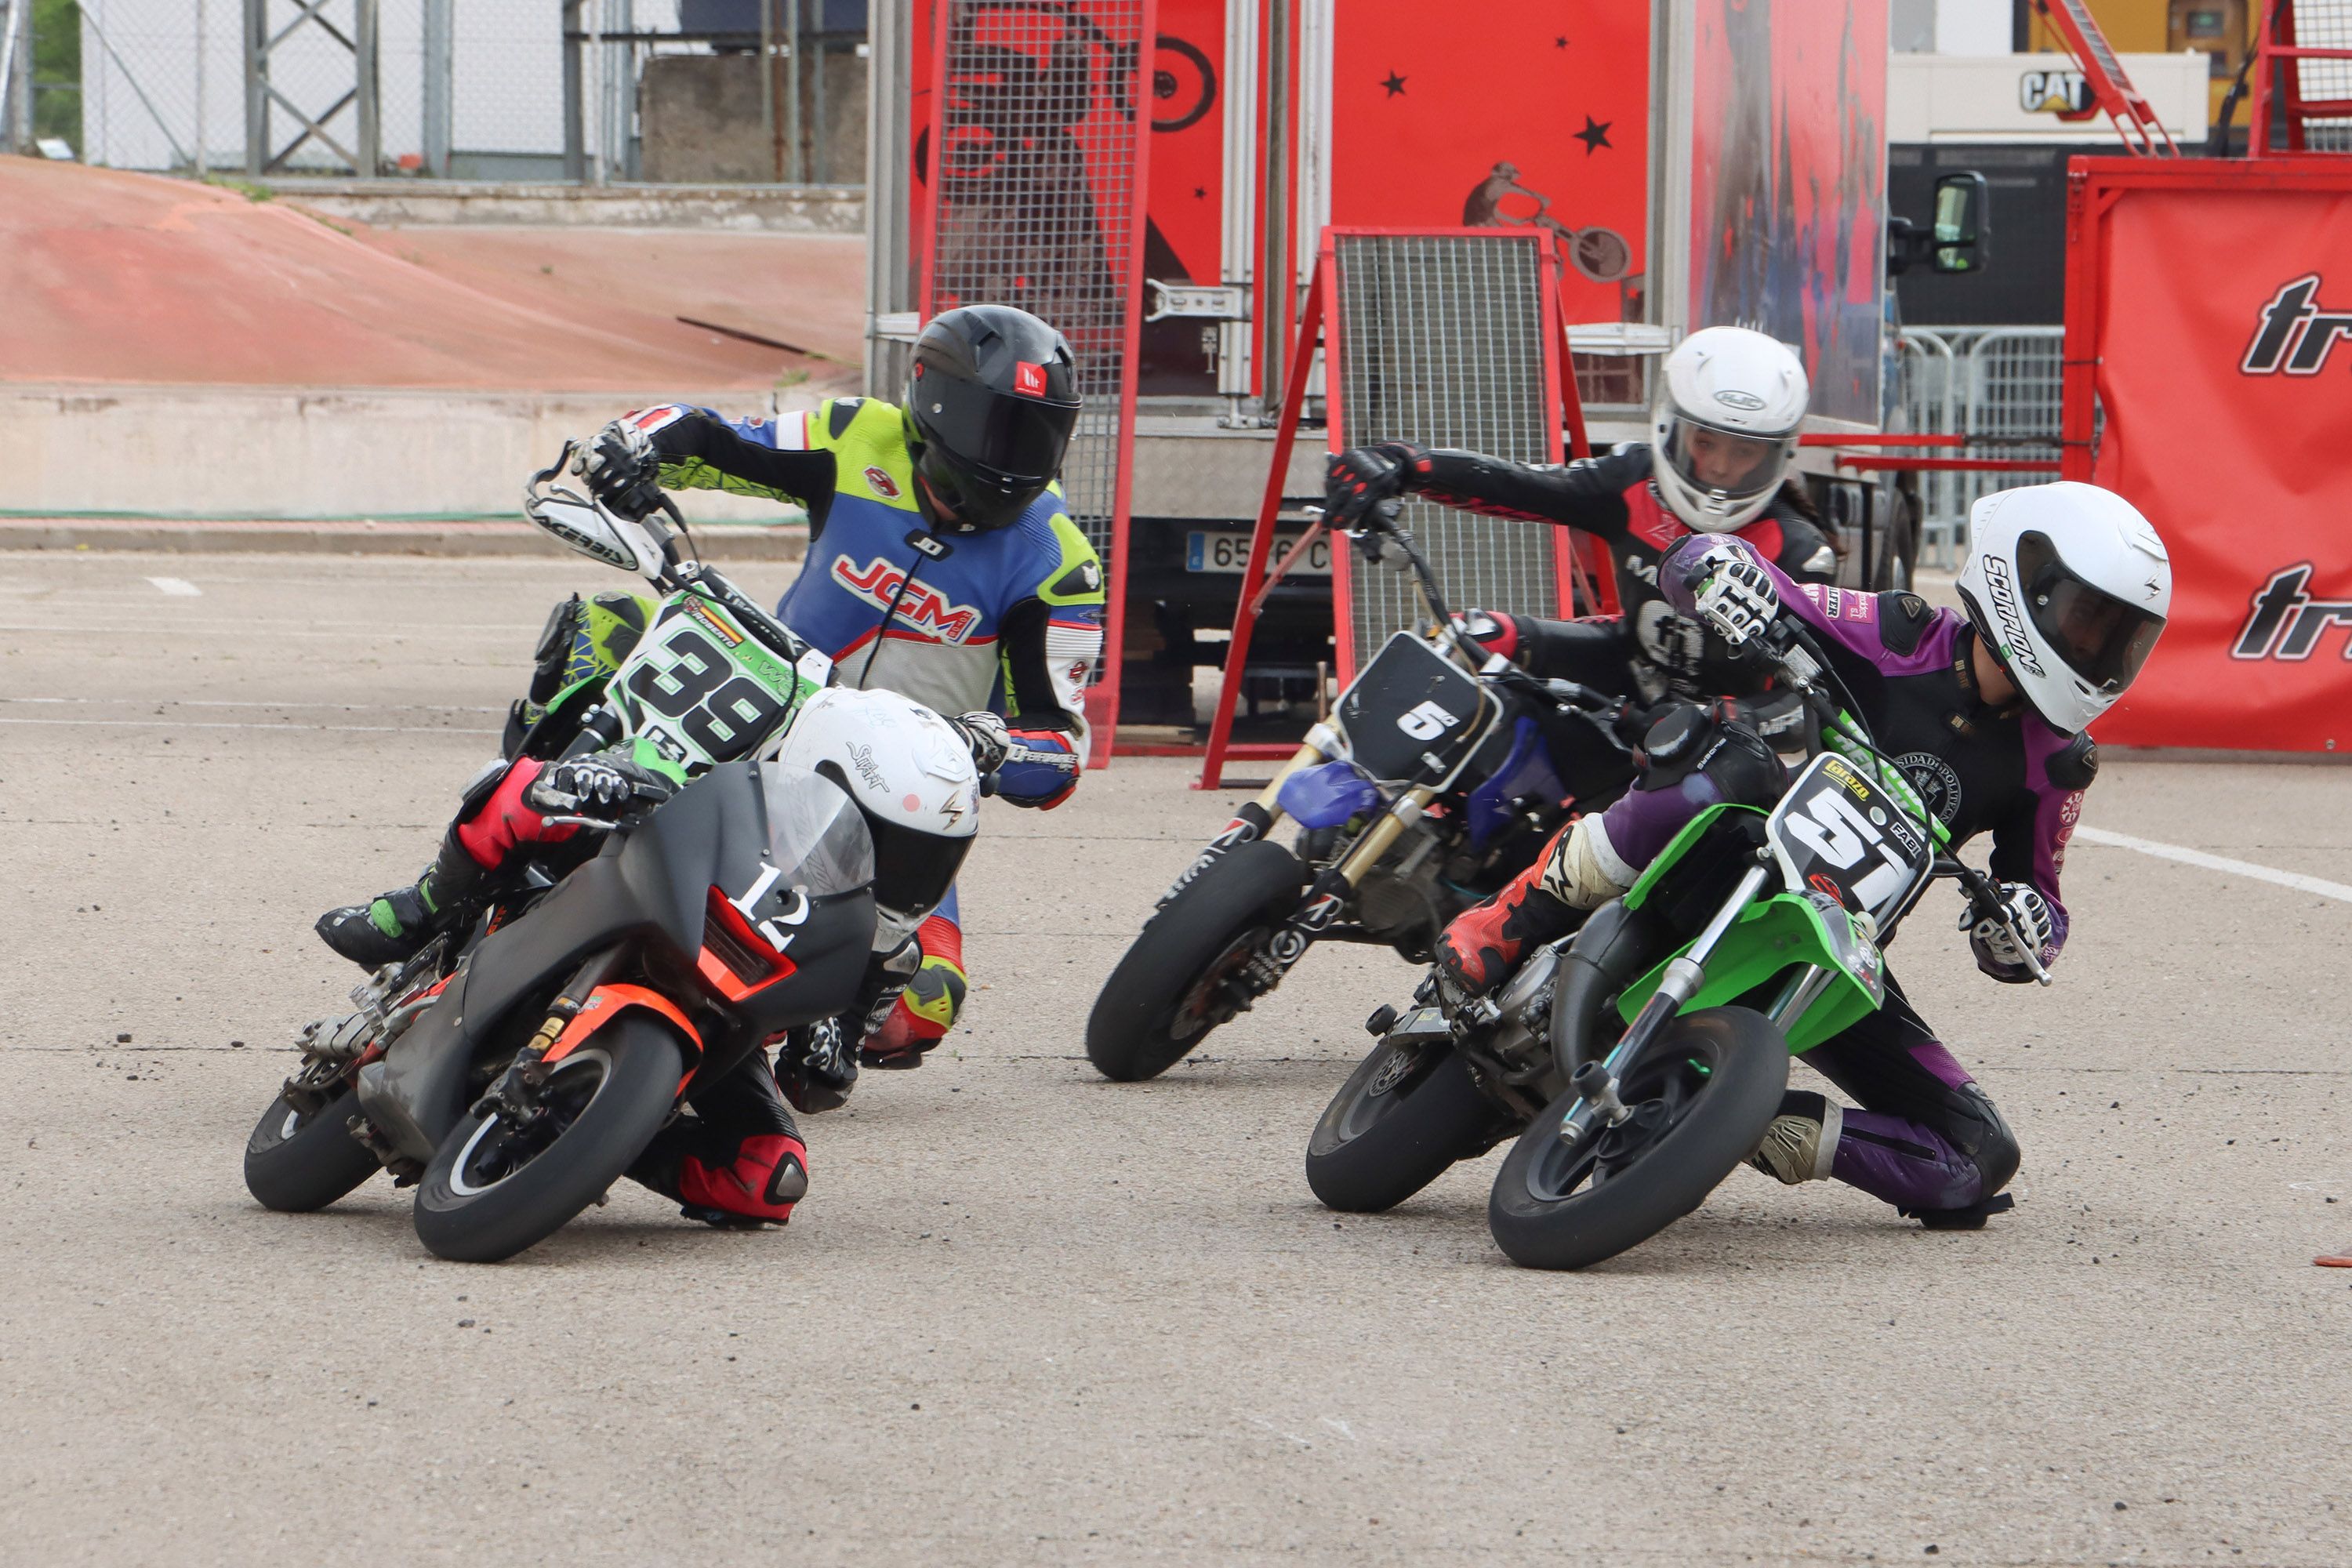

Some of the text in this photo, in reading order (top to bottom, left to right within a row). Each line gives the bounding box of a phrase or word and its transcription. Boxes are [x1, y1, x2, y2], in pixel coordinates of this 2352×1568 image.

[2023, 73, 2085, 111] CAT
[2241, 275, 2352, 374] tr
[836, 560, 975, 640] JGM
[1215, 538, 1292, 567] 656
[1983, 554, 2047, 677] SCORPION
[2232, 564, 2352, 659] tr
[628, 630, 786, 764] 39
[1784, 786, 1918, 912] 51
[728, 861, 810, 952] 12
